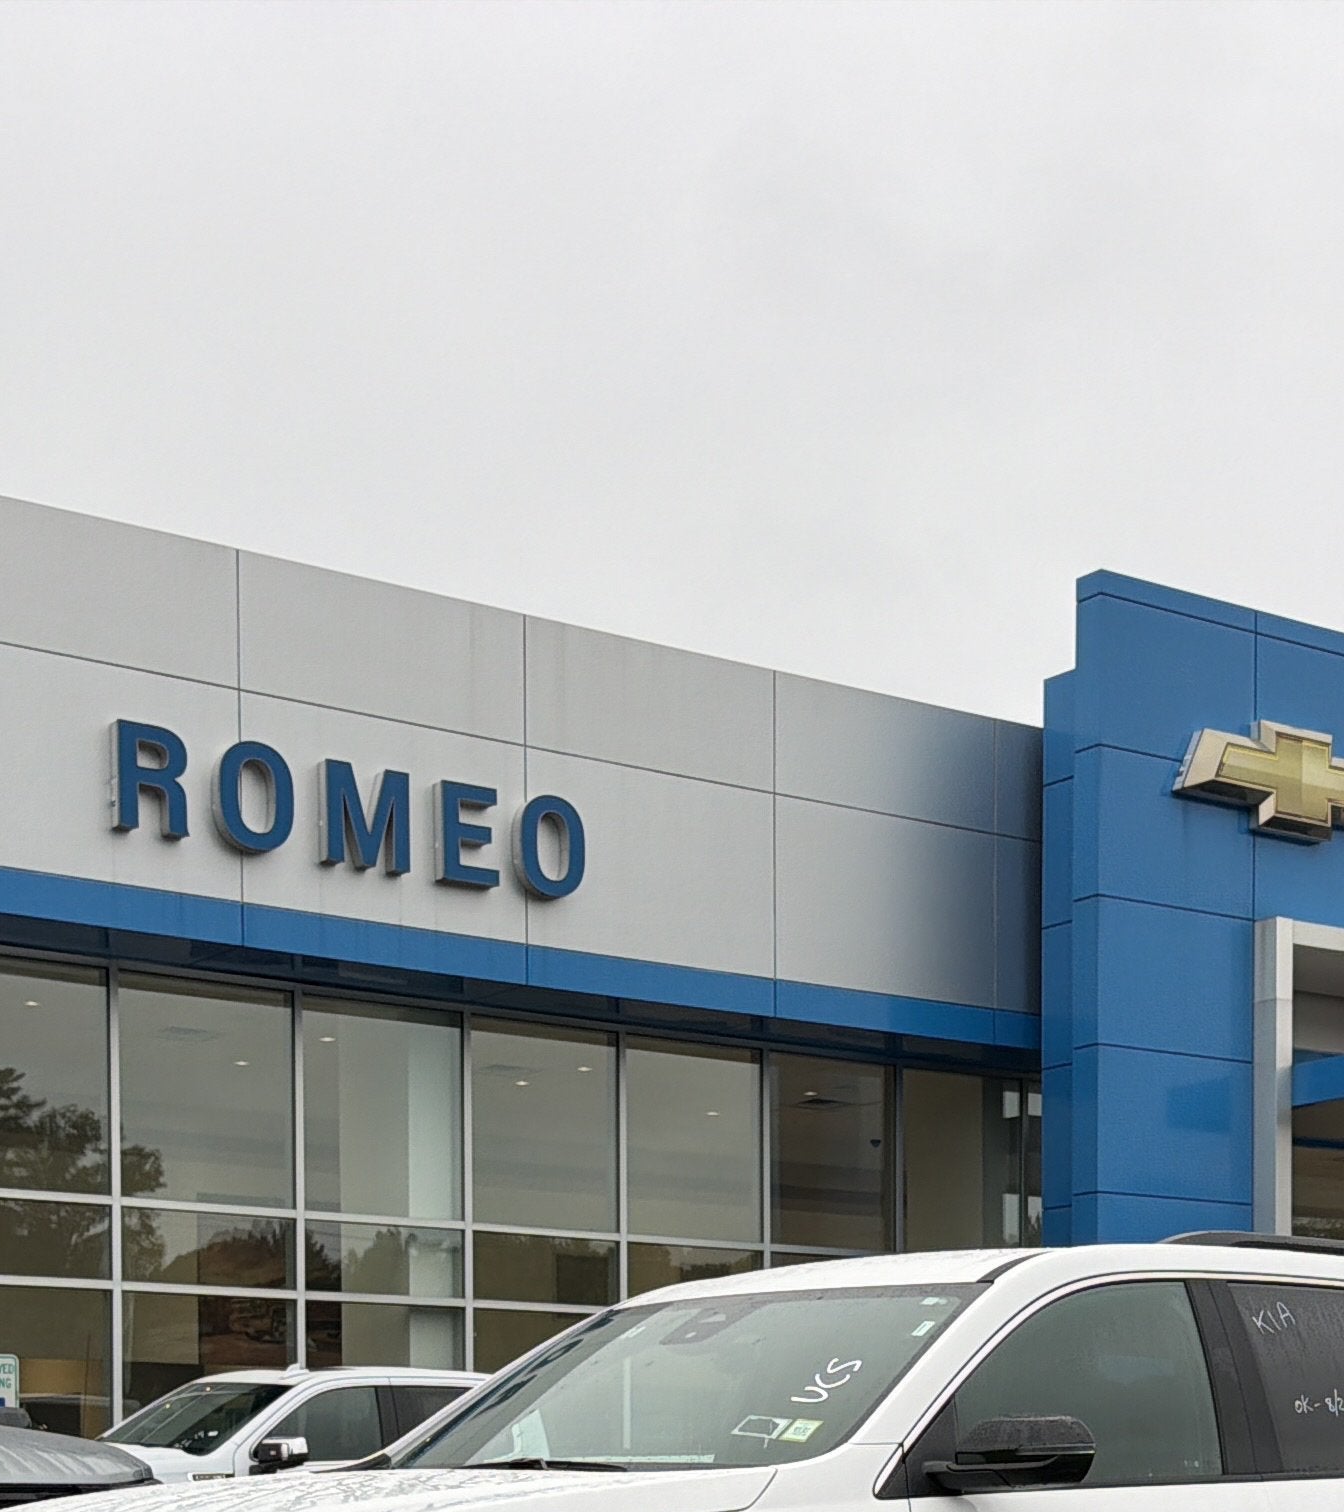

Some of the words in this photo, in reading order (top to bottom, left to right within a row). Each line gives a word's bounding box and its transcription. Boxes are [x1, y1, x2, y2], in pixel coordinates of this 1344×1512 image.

[111, 719, 586, 900] ROMEO
[1251, 1301, 1296, 1335] KIA
[790, 1357, 863, 1403] UCS
